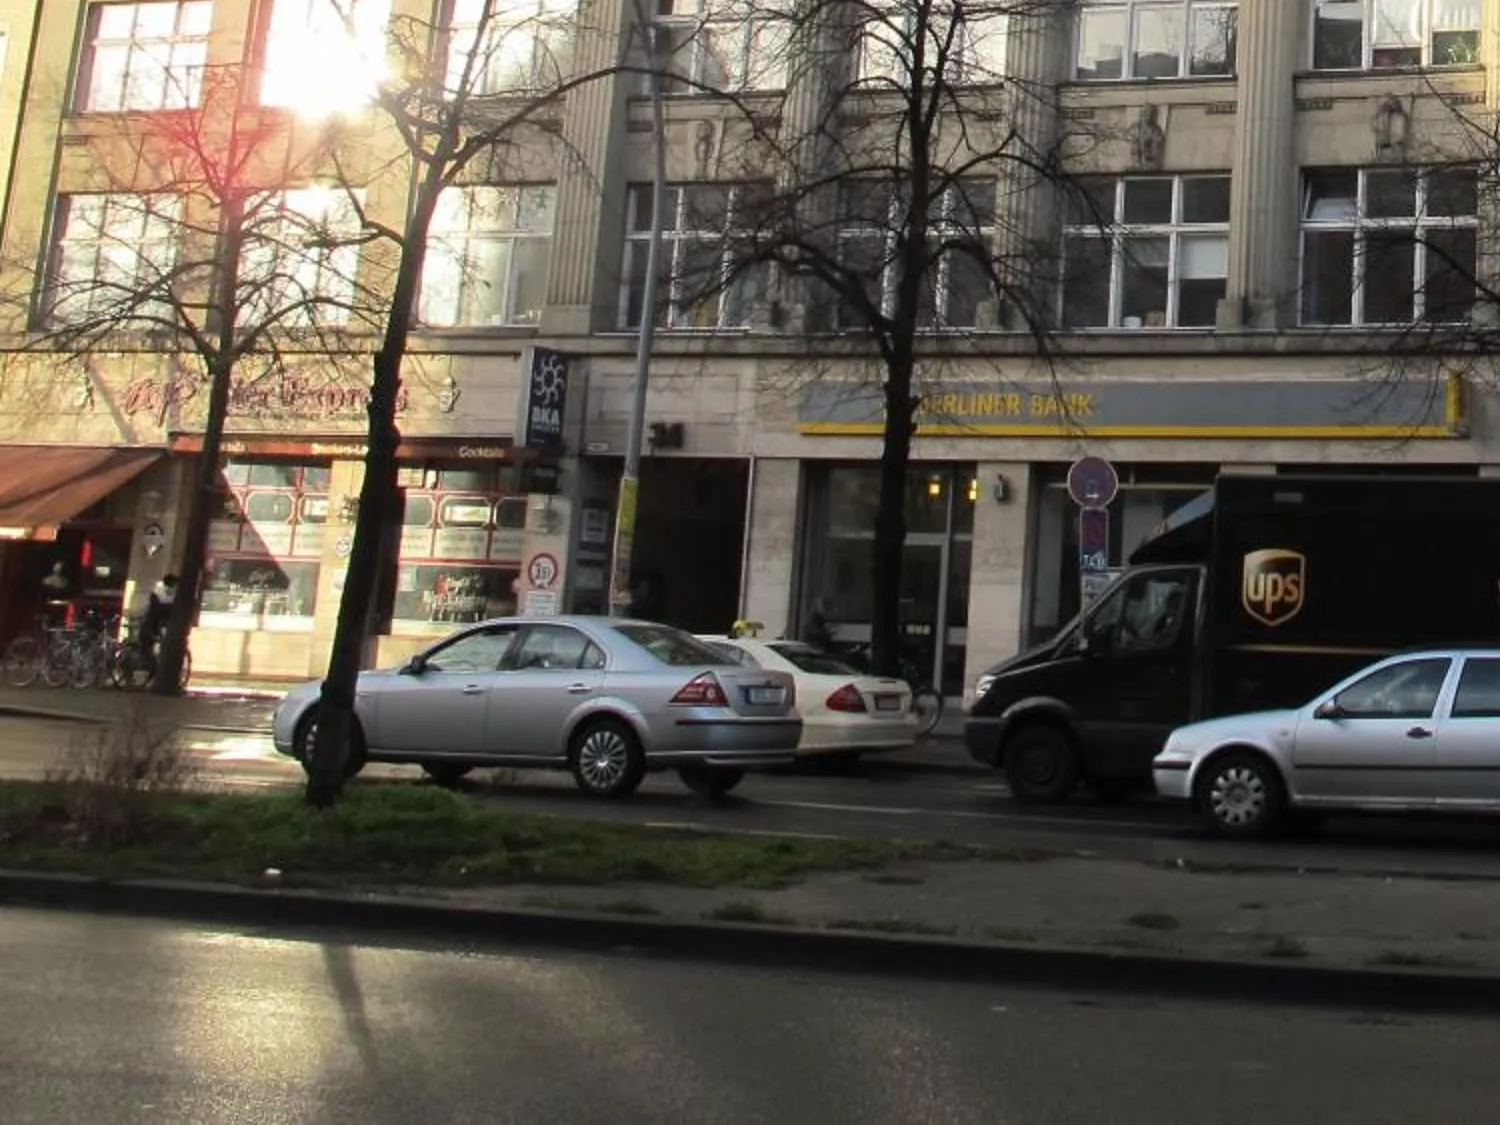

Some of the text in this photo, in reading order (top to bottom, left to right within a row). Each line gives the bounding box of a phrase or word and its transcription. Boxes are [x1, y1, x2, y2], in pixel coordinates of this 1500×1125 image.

[919, 392, 1094, 416] BERLINER BANK
[1247, 572, 1299, 614] ups
